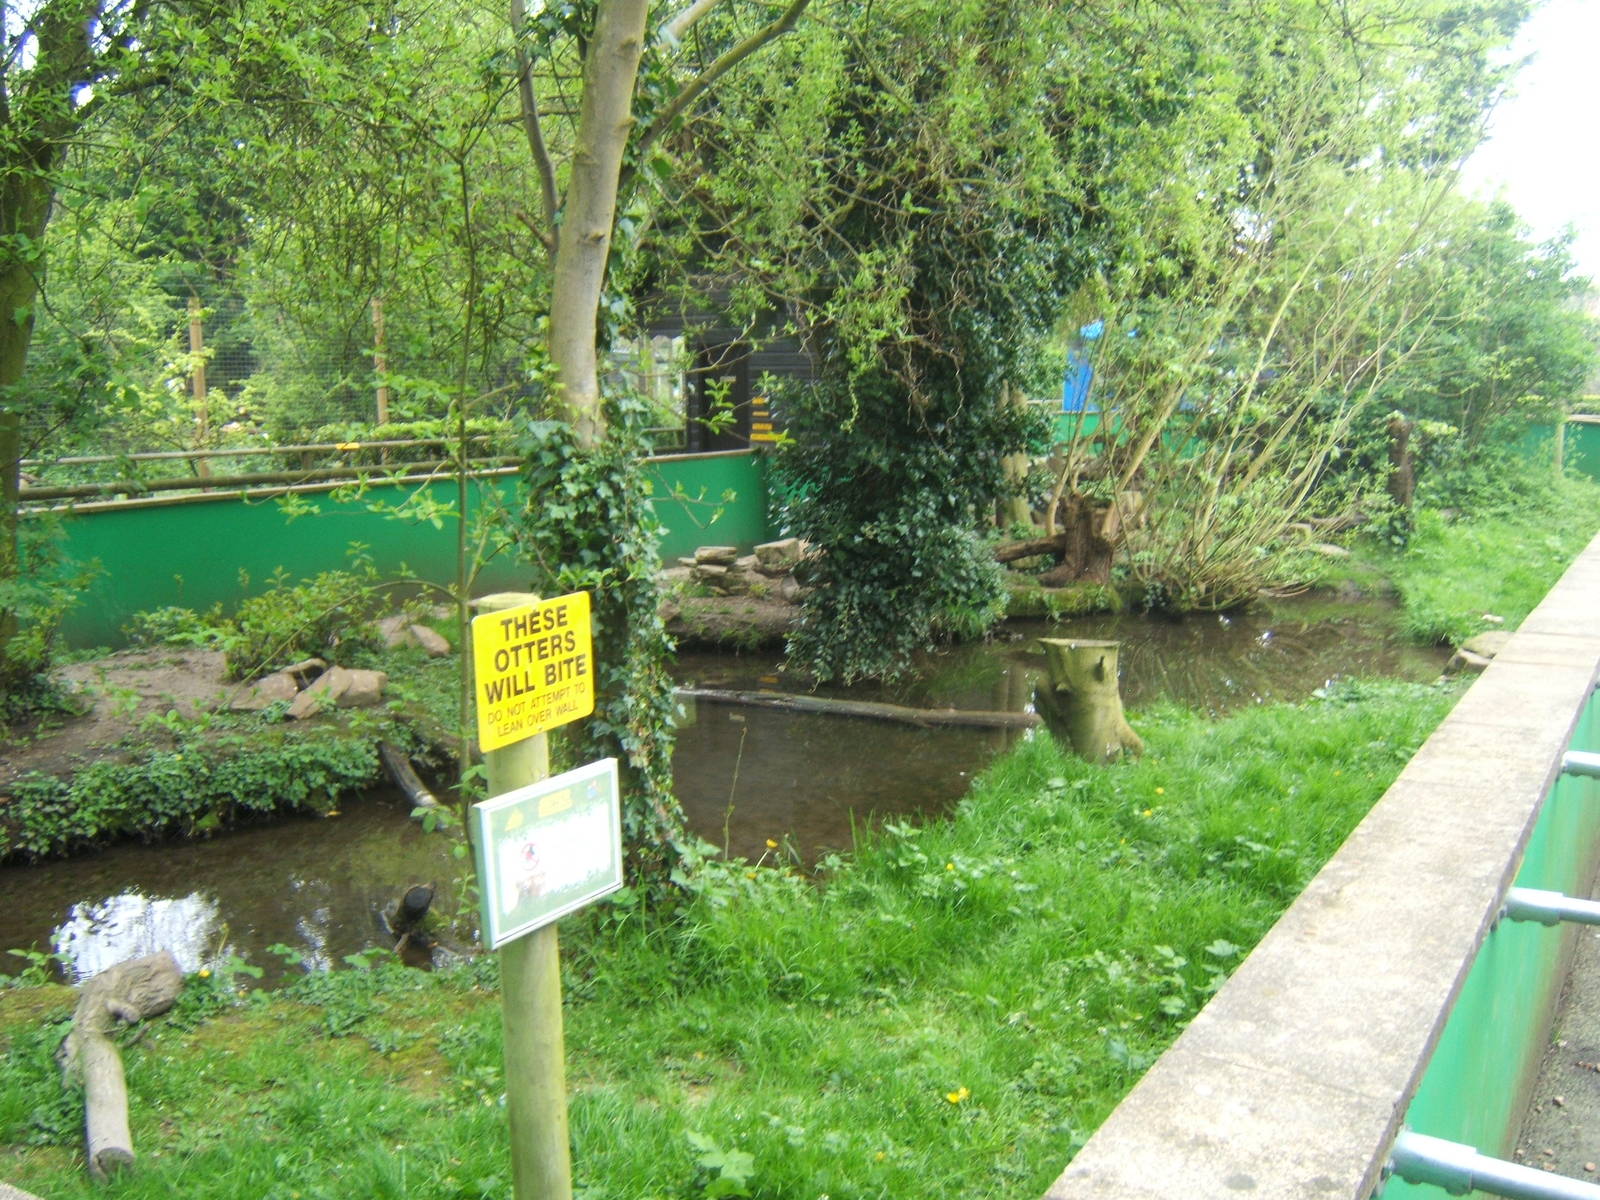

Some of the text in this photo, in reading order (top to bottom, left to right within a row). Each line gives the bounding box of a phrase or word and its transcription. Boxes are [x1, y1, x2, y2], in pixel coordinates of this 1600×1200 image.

[501, 605, 568, 641] THESE
[494, 630, 576, 672] OTTERS
[484, 654, 586, 704] WILL BITE
[488, 682, 585, 725] DO NOT ATTEMPT TO
[497, 701, 578, 737] LEAN OVER WALL
